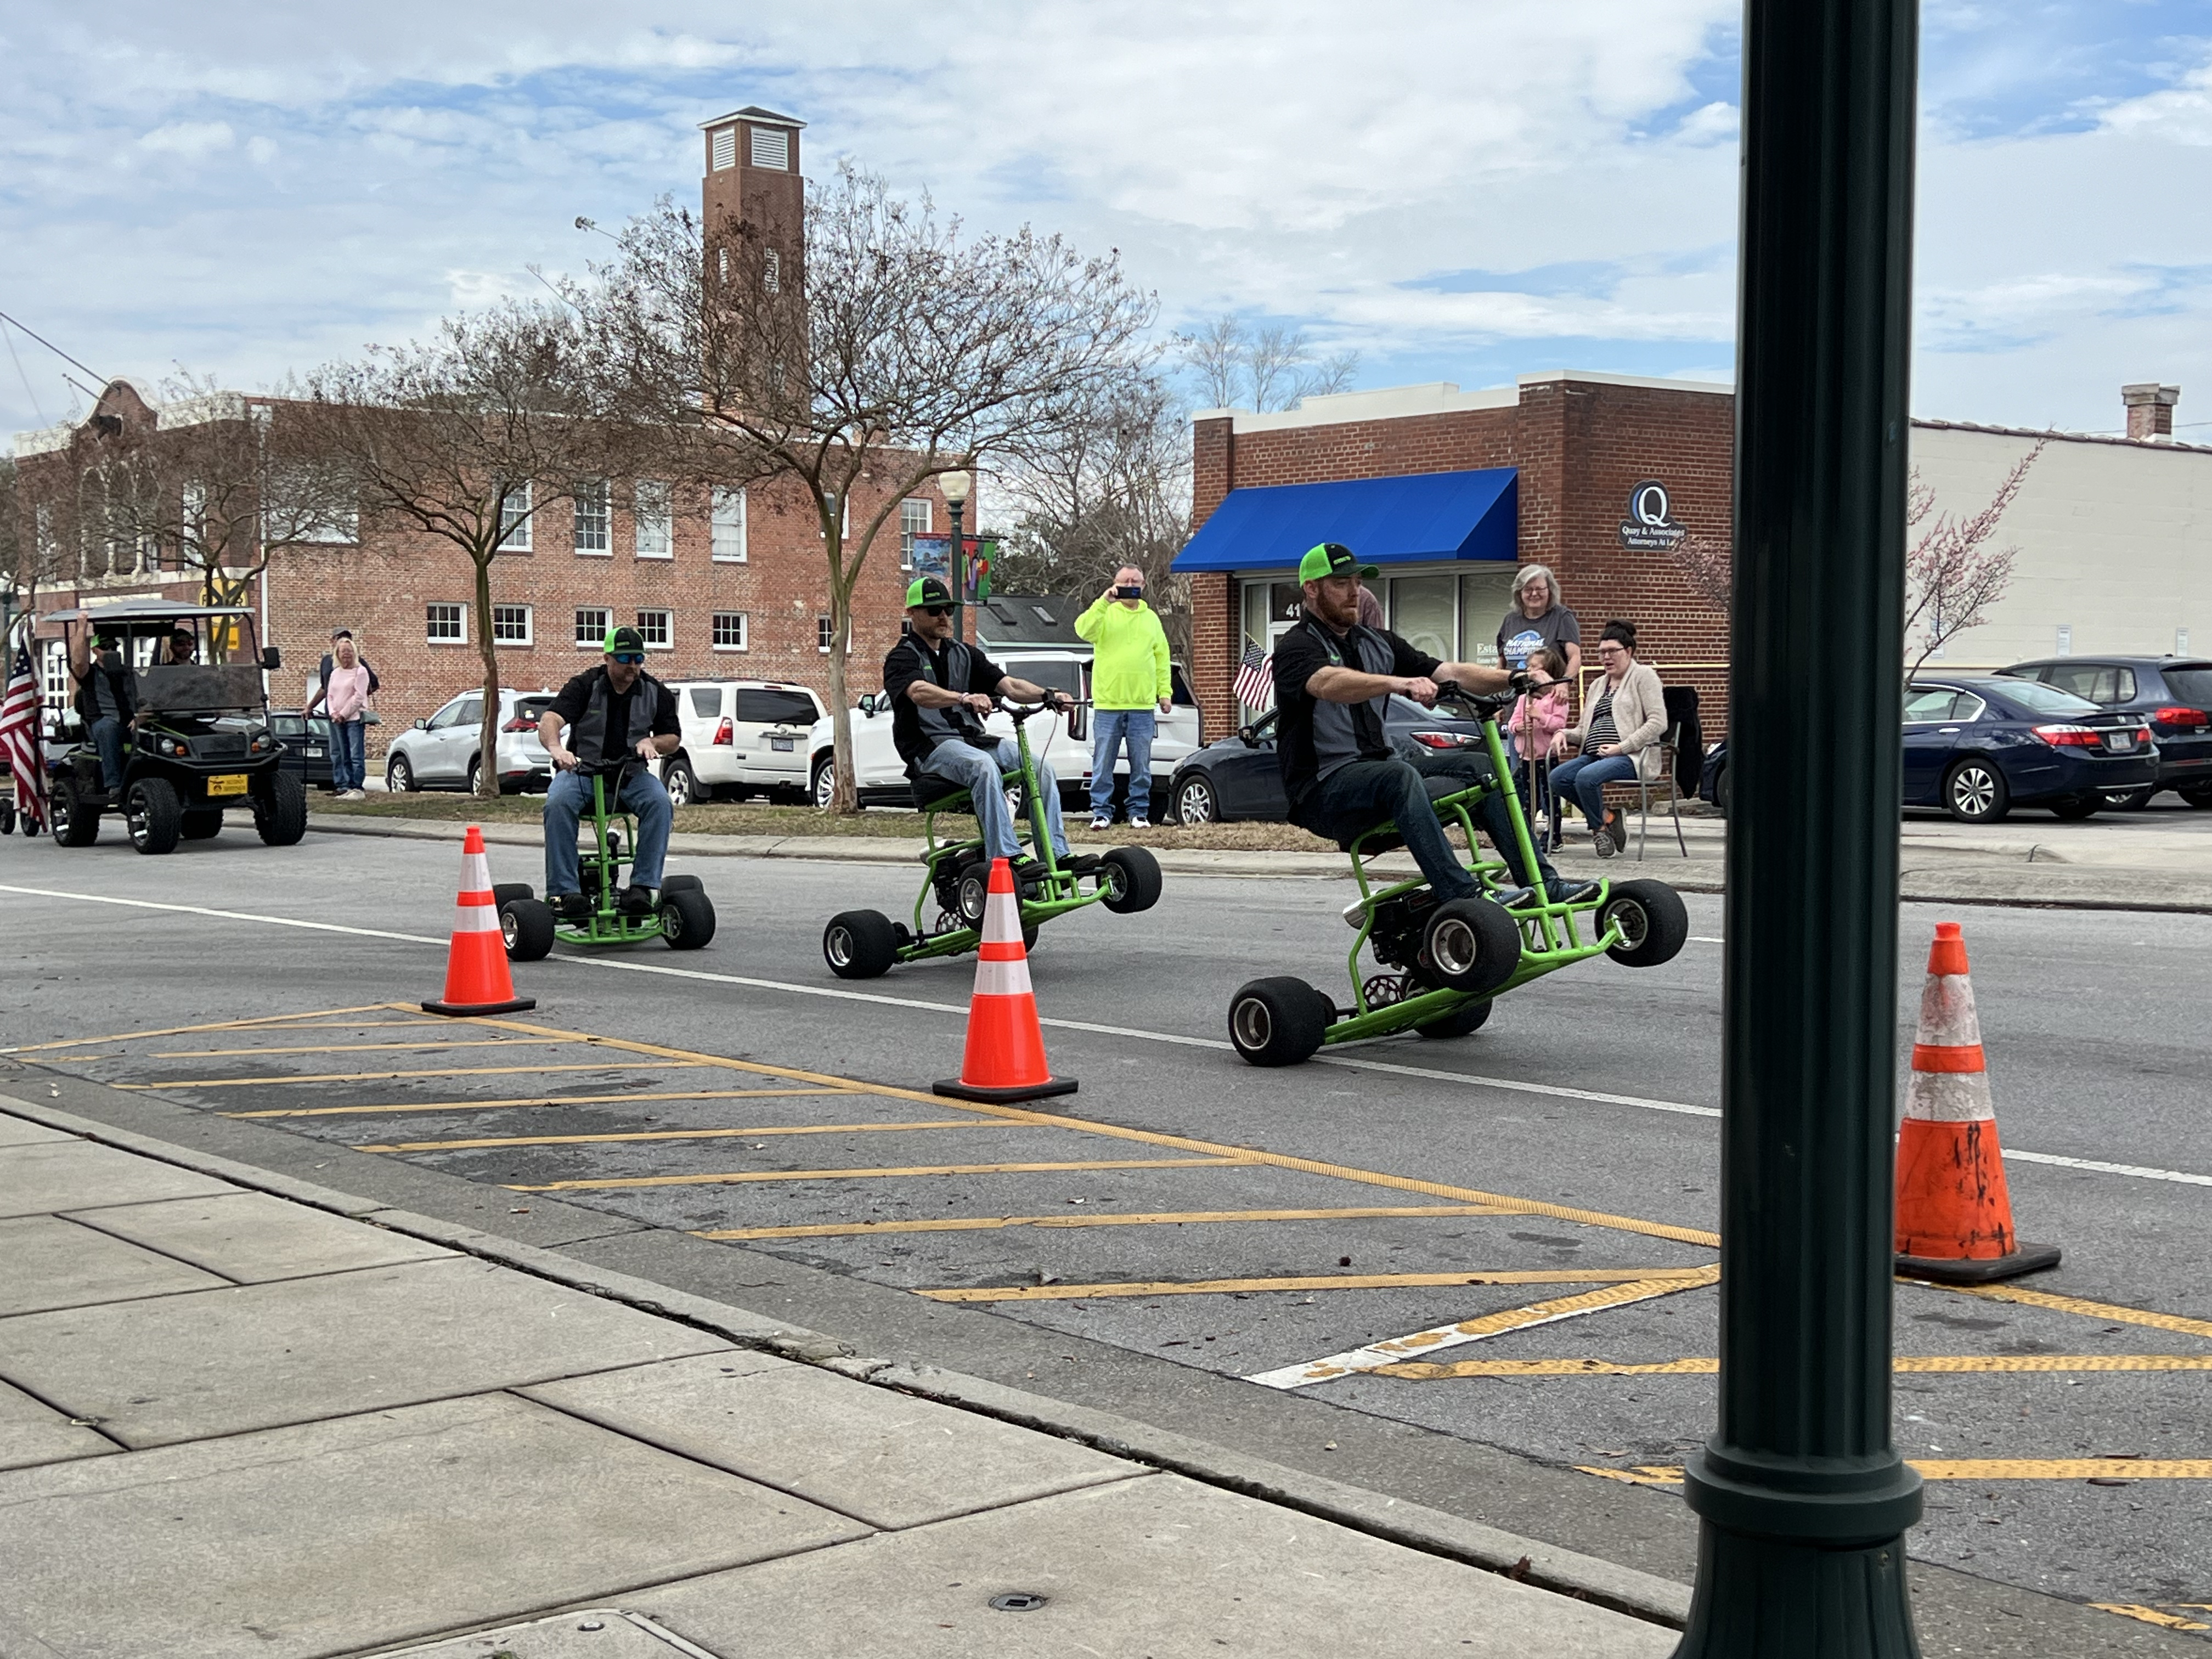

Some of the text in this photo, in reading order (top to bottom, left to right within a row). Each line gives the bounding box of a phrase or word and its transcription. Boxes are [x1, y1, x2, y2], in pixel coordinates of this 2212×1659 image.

[1639, 486, 1671, 527] Q
[1622, 526, 1641, 537] Quay
[1649, 528, 1685, 538] Associates
[1627, 537, 1657, 547] Attorneys
[1477, 644, 1498, 653] Esta
